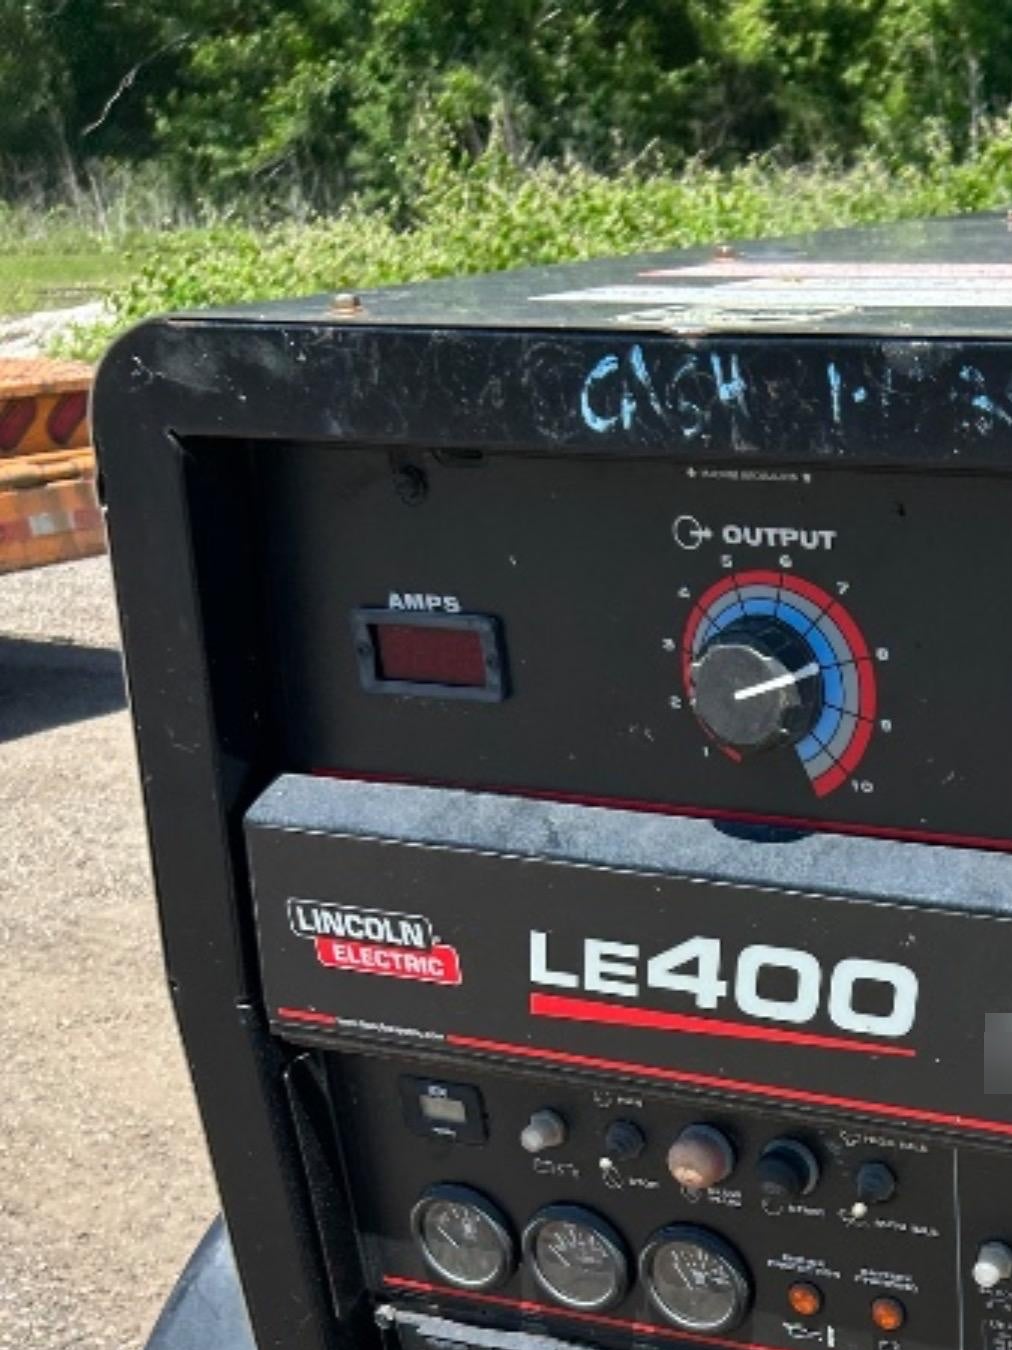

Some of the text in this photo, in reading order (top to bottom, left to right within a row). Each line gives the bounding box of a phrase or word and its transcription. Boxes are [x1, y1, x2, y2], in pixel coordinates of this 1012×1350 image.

[721, 524, 838, 550] OUTPUT
[779, 554, 793, 568] 6
[837, 581, 850, 595] 7
[389, 591, 462, 614] AMPS
[851, 780, 874, 793] 10
[296, 905, 426, 948] LINCOLN
[331, 943, 445, 977] ELECTRIC
[529, 929, 919, 1038] LE400
